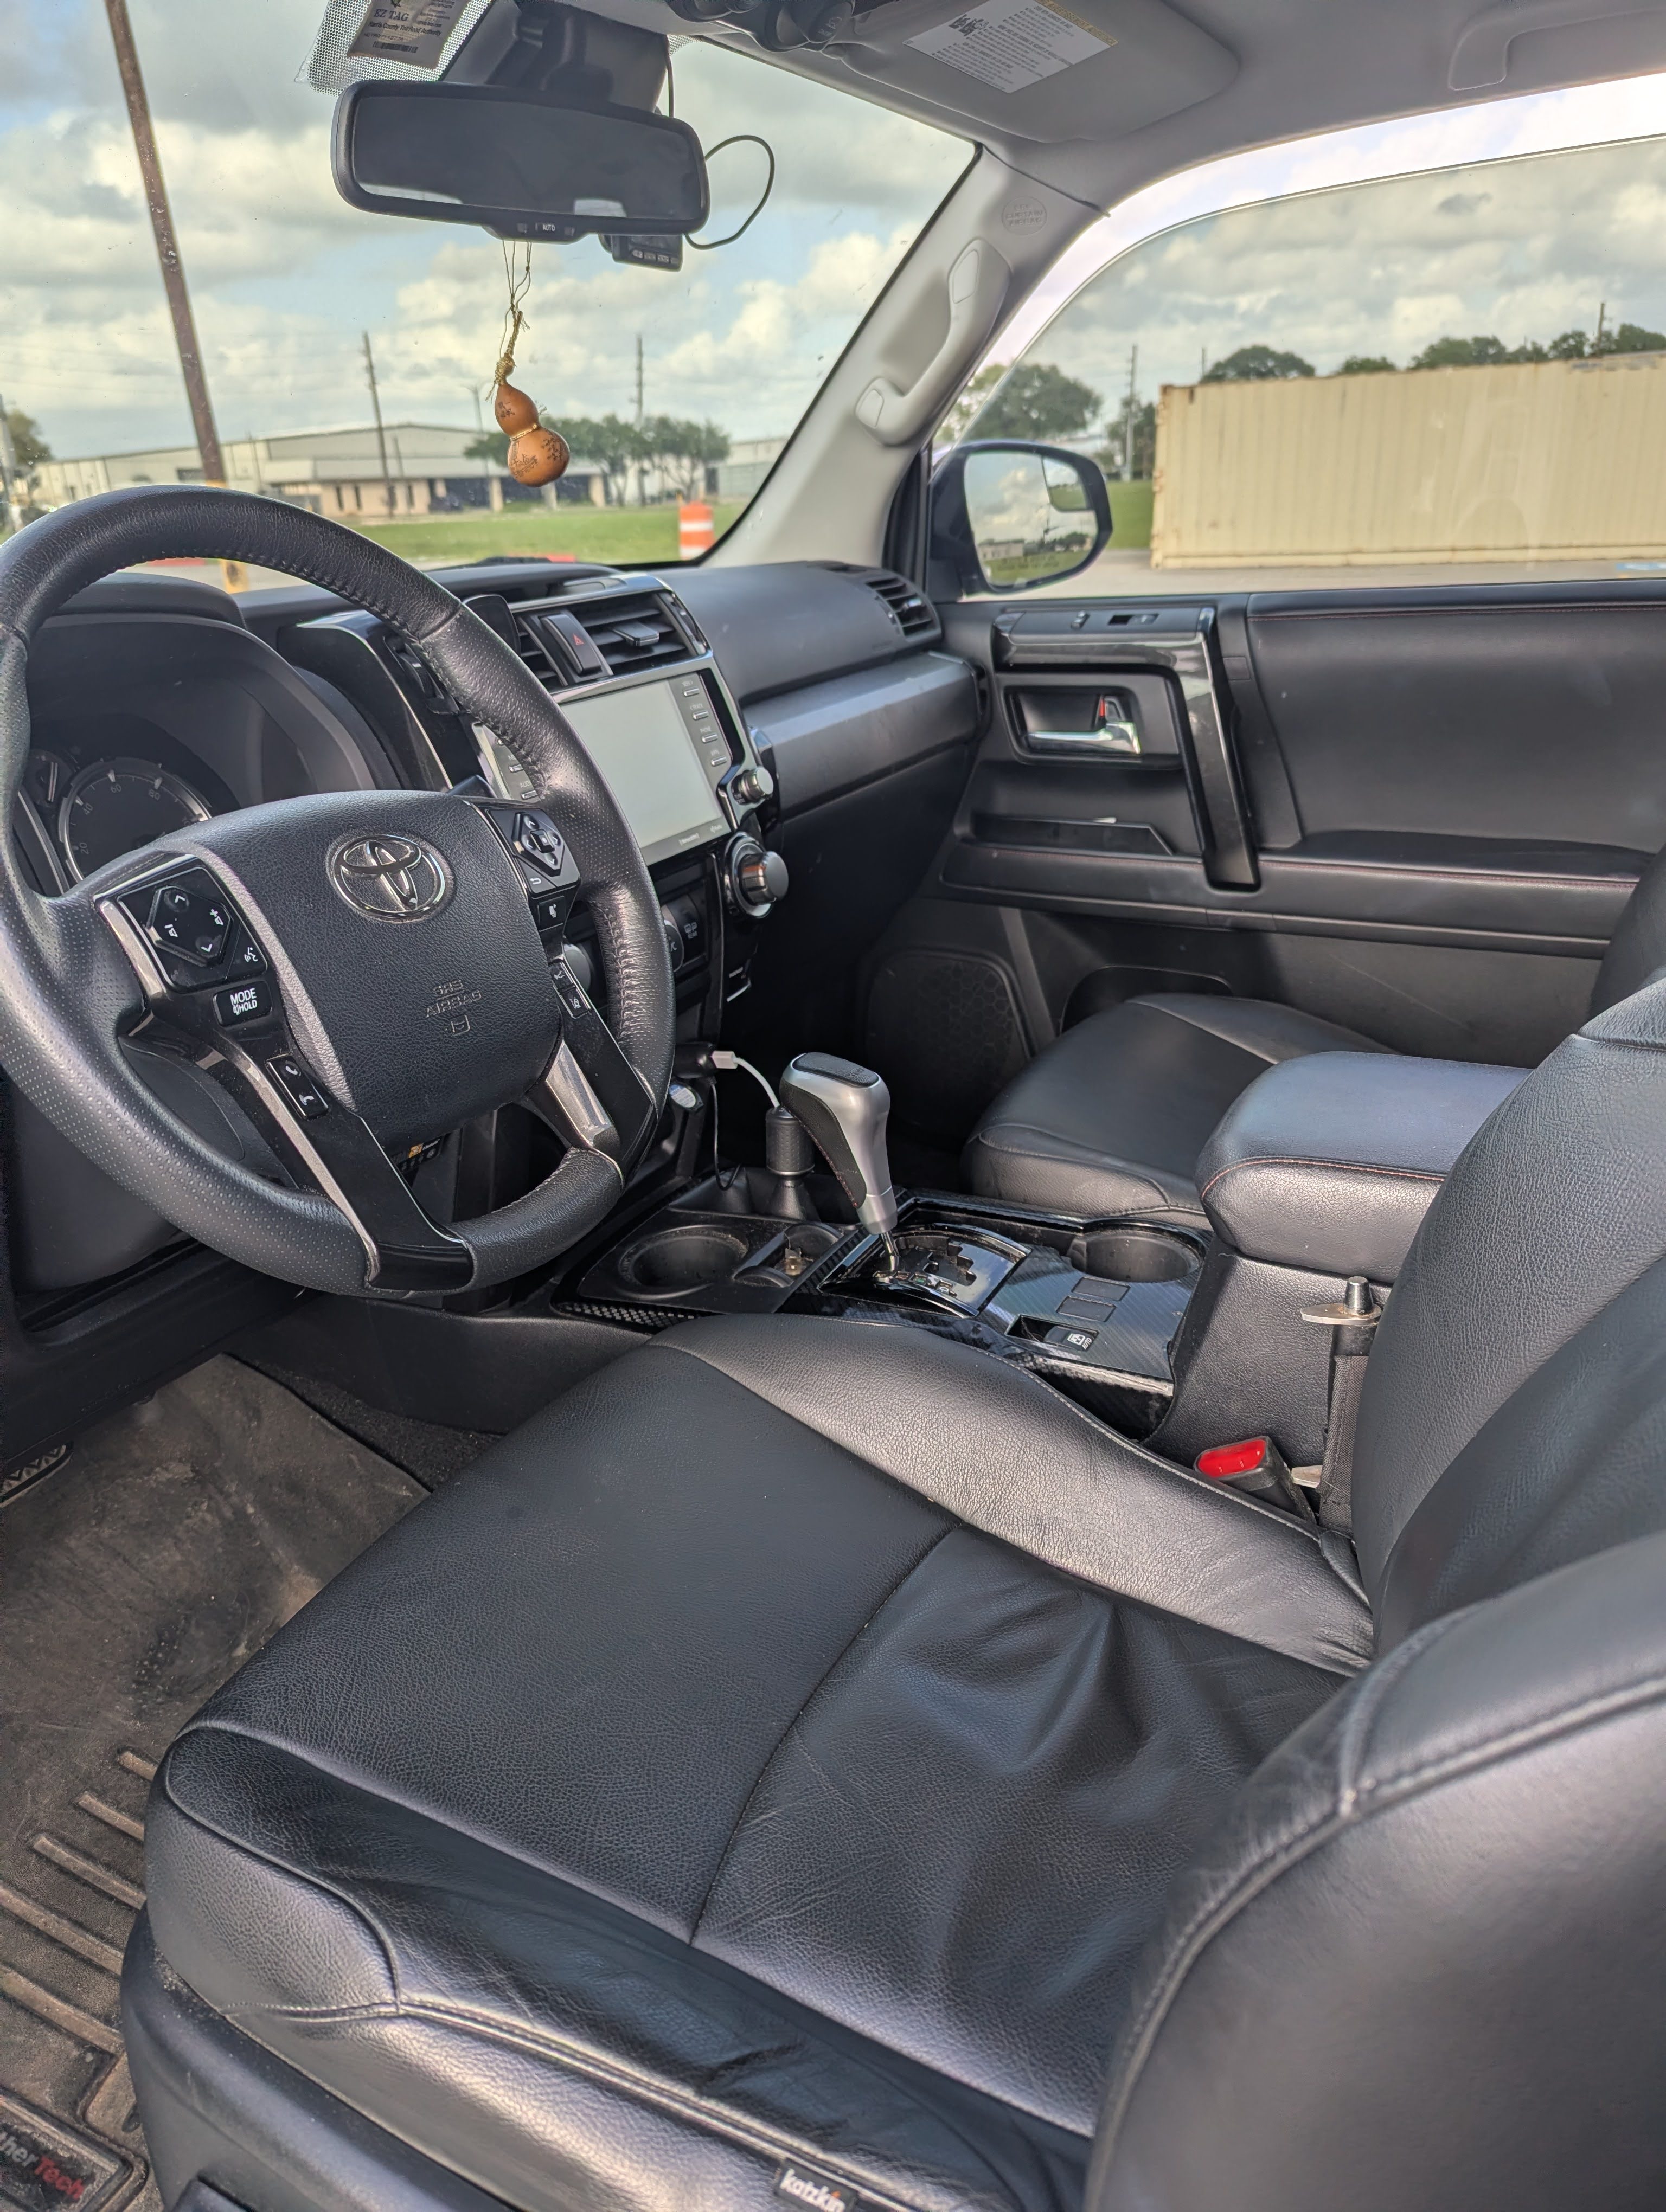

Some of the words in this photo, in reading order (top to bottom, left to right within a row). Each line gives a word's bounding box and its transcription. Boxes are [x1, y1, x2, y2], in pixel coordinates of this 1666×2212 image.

[373, 9, 388, 18] EZ
[389, 11, 409, 21] TAG
[110, 783, 122, 793] 60
[148, 789, 161, 801] 80
[84, 802, 94, 815] 40
[79, 841, 91, 855] 20
[433, 979, 463, 998] SRS
[230, 987, 257, 1006] MODE
[239, 999, 258, 1013] HOLD
[426, 989, 482, 1018] AIRBAG
[1081, 1337, 1092, 1350] AUTO
